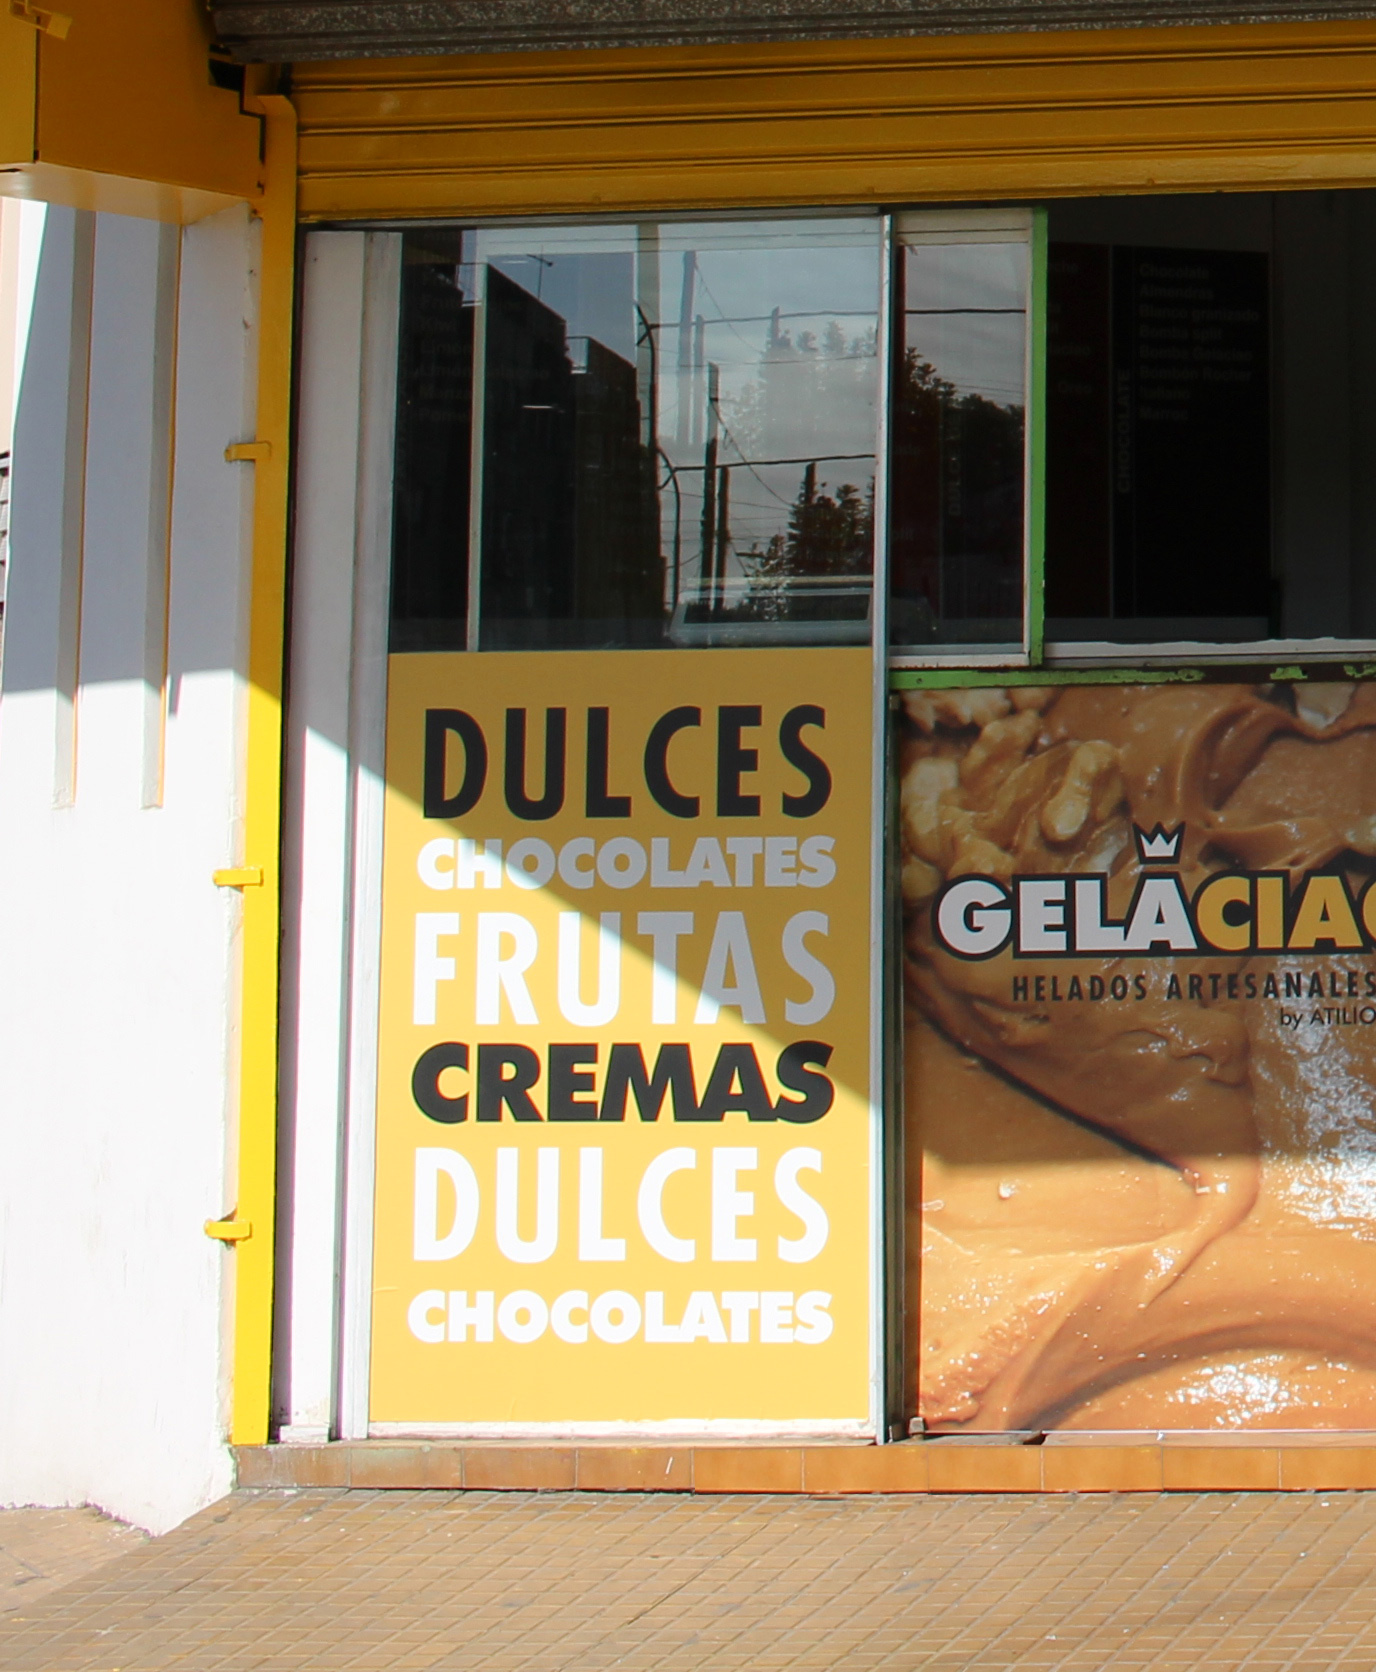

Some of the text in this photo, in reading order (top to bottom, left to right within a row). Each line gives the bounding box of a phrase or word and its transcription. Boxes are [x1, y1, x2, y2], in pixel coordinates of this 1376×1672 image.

[422, 704, 833, 822] DULCES
[416, 835, 837, 890] CHOCOLATES
[412, 910, 836, 1028] FRUTAS
[1012, 973, 1148, 1002] HELADOS
[1280, 1006, 1304, 1030] by
[410, 1039, 835, 1125] CREMAS
[412, 1146, 830, 1264] DULCES
[406, 1289, 834, 1345] CHOCOLATES
